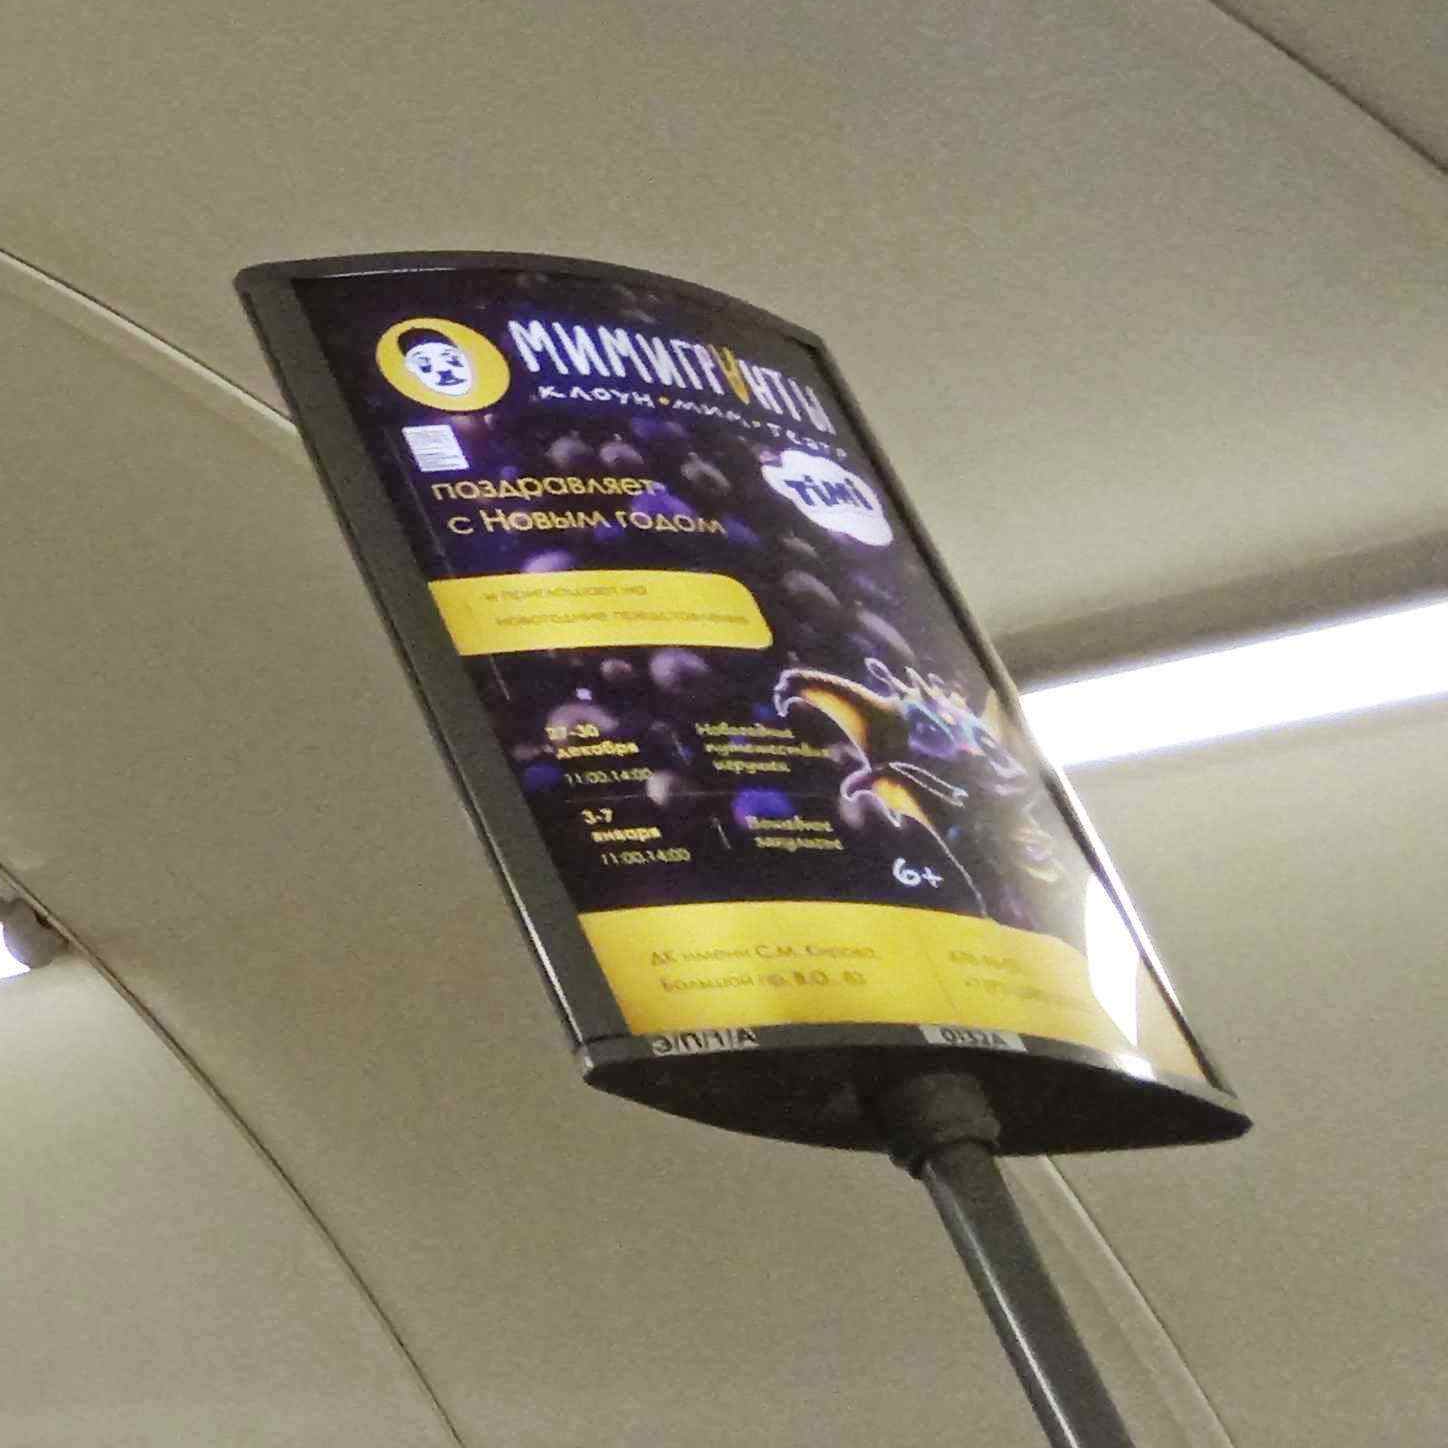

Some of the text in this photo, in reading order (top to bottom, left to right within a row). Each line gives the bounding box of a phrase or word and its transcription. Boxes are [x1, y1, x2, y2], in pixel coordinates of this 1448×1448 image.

[508, 319, 837, 436] МИМИГРАНТЫ
[431, 476, 656, 502] поздравляет
[480, 509, 608, 534] Новым
[615, 510, 728, 536] годом
[891, 857, 943, 888] 6+
